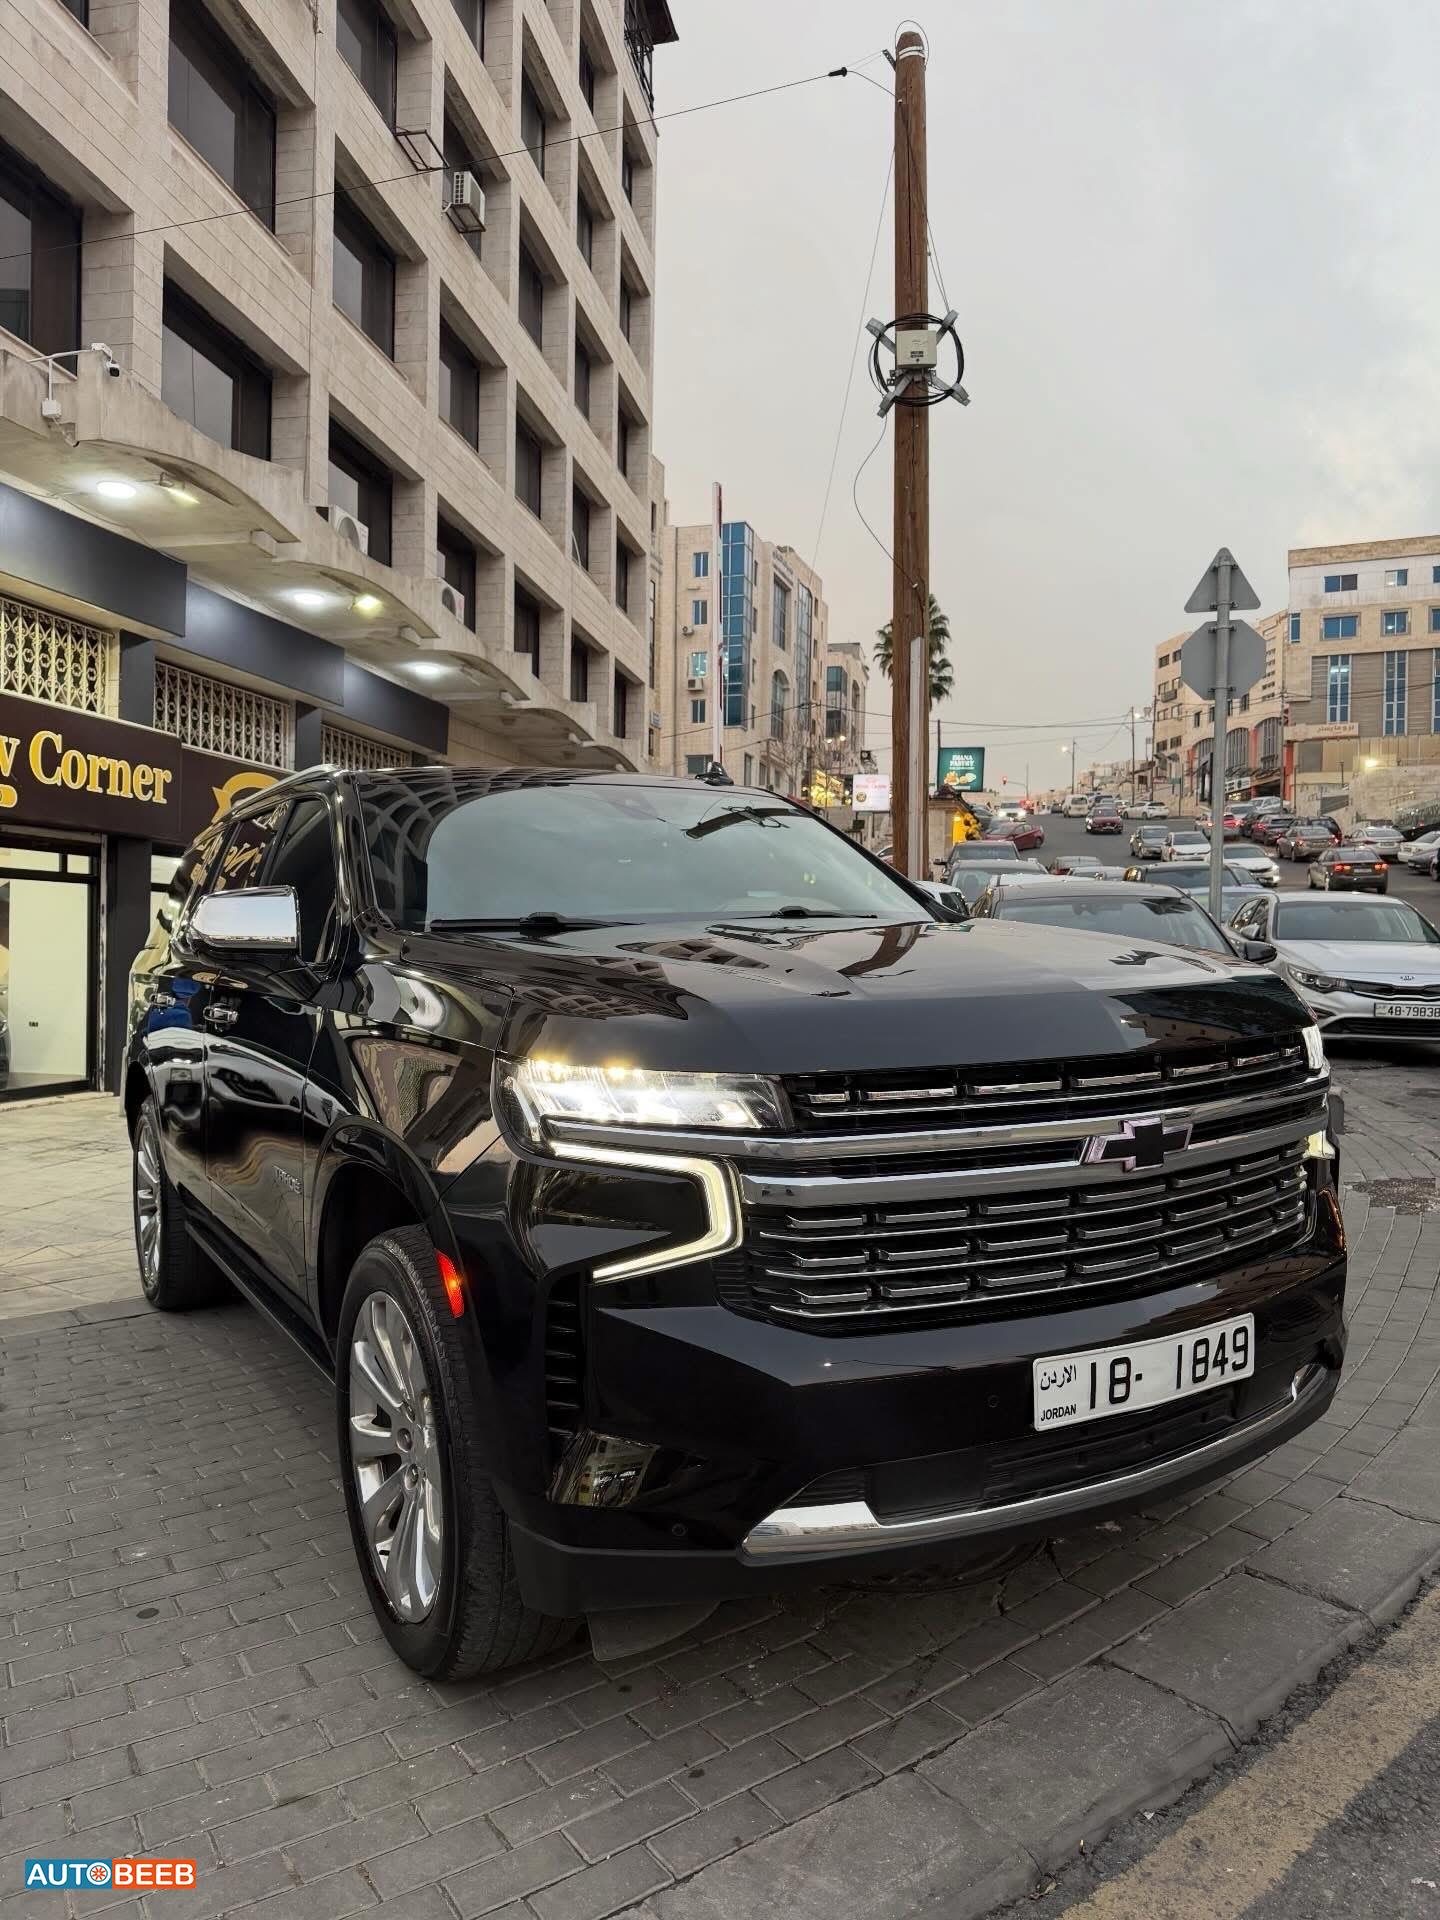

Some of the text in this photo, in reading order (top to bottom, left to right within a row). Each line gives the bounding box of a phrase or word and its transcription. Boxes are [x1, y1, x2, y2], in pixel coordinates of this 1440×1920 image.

[29, 730, 172, 804] Corner
[1175, 1325, 1249, 1390] 1849
[1040, 1404, 1077, 1422] JORDAN
